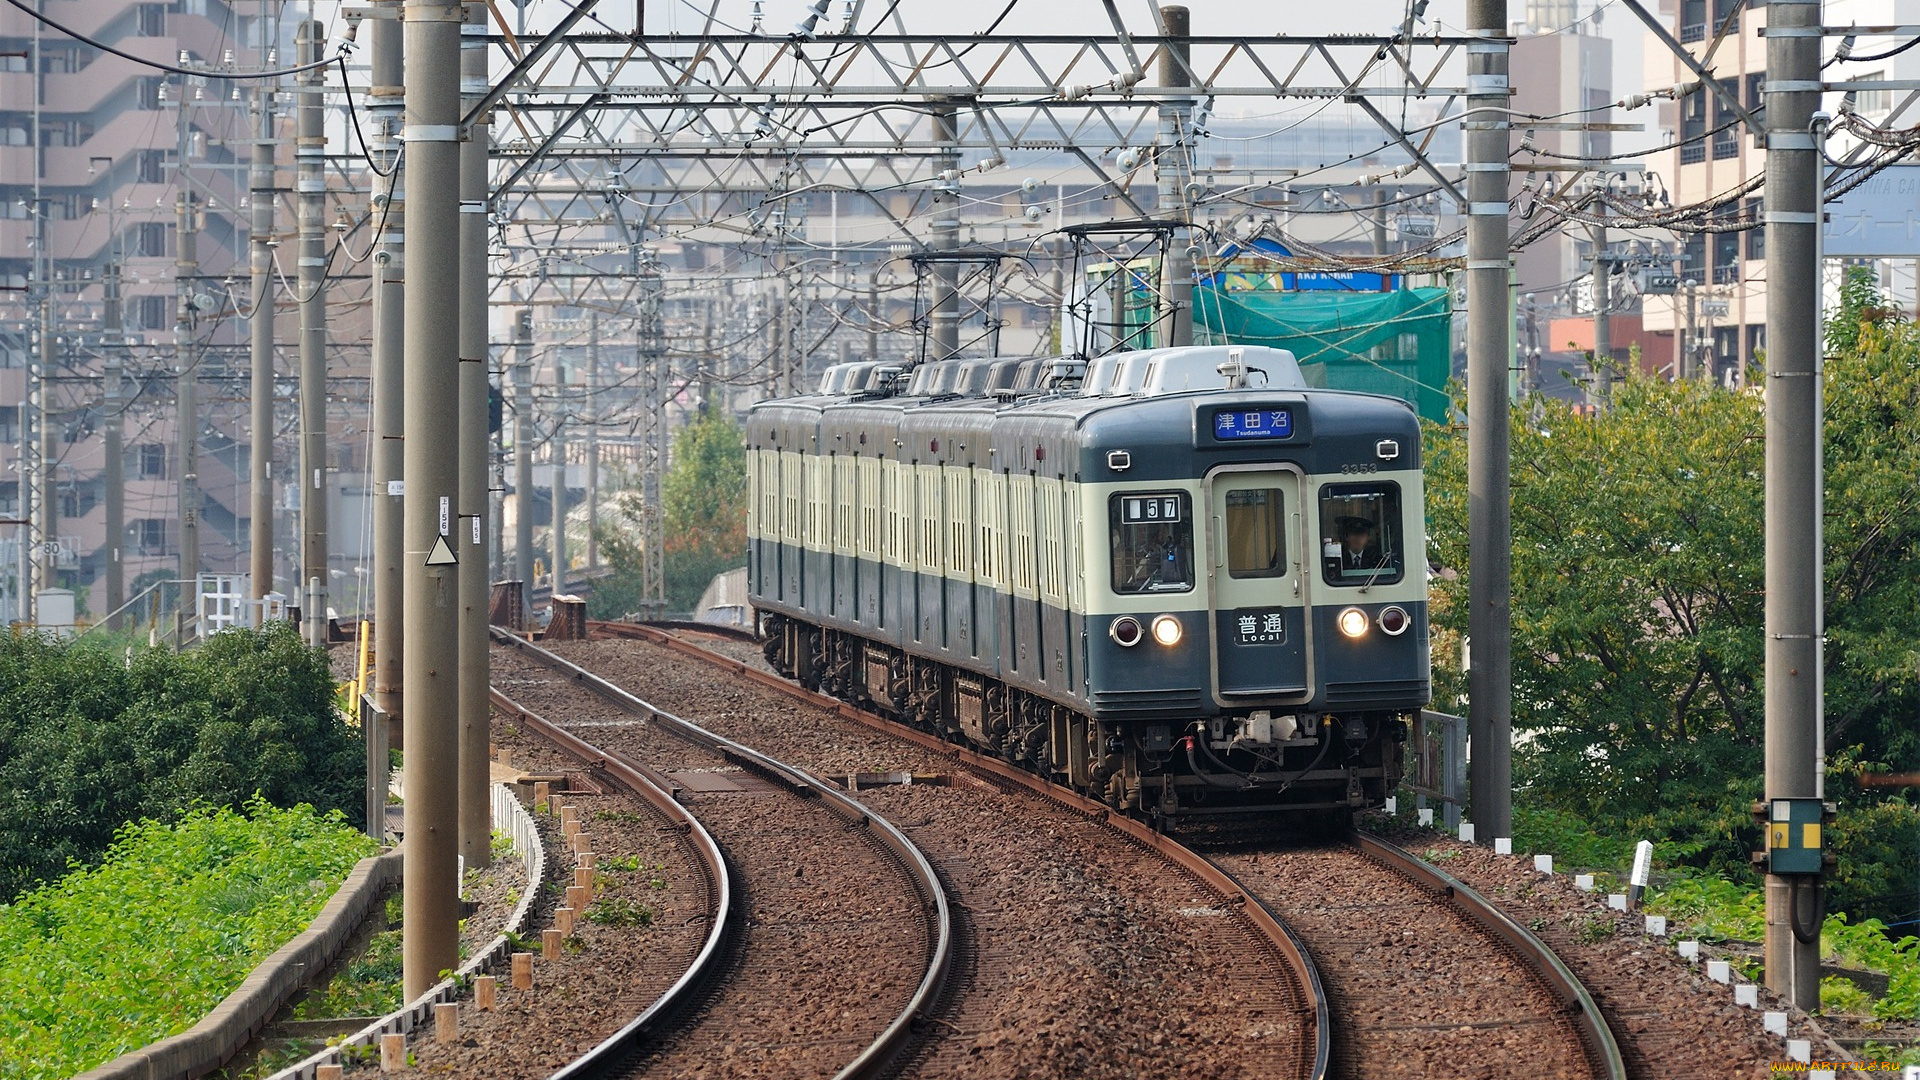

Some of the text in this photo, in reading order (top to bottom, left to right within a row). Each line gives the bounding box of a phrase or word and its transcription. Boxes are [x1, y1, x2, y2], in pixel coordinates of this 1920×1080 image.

[1218, 411, 1287, 430] 津田沼
[1341, 462, 1377, 475] 3353
[44, 543, 59, 554] 80
[1238, 613, 1283, 634] 普通
[1242, 632, 1279, 642] Local
